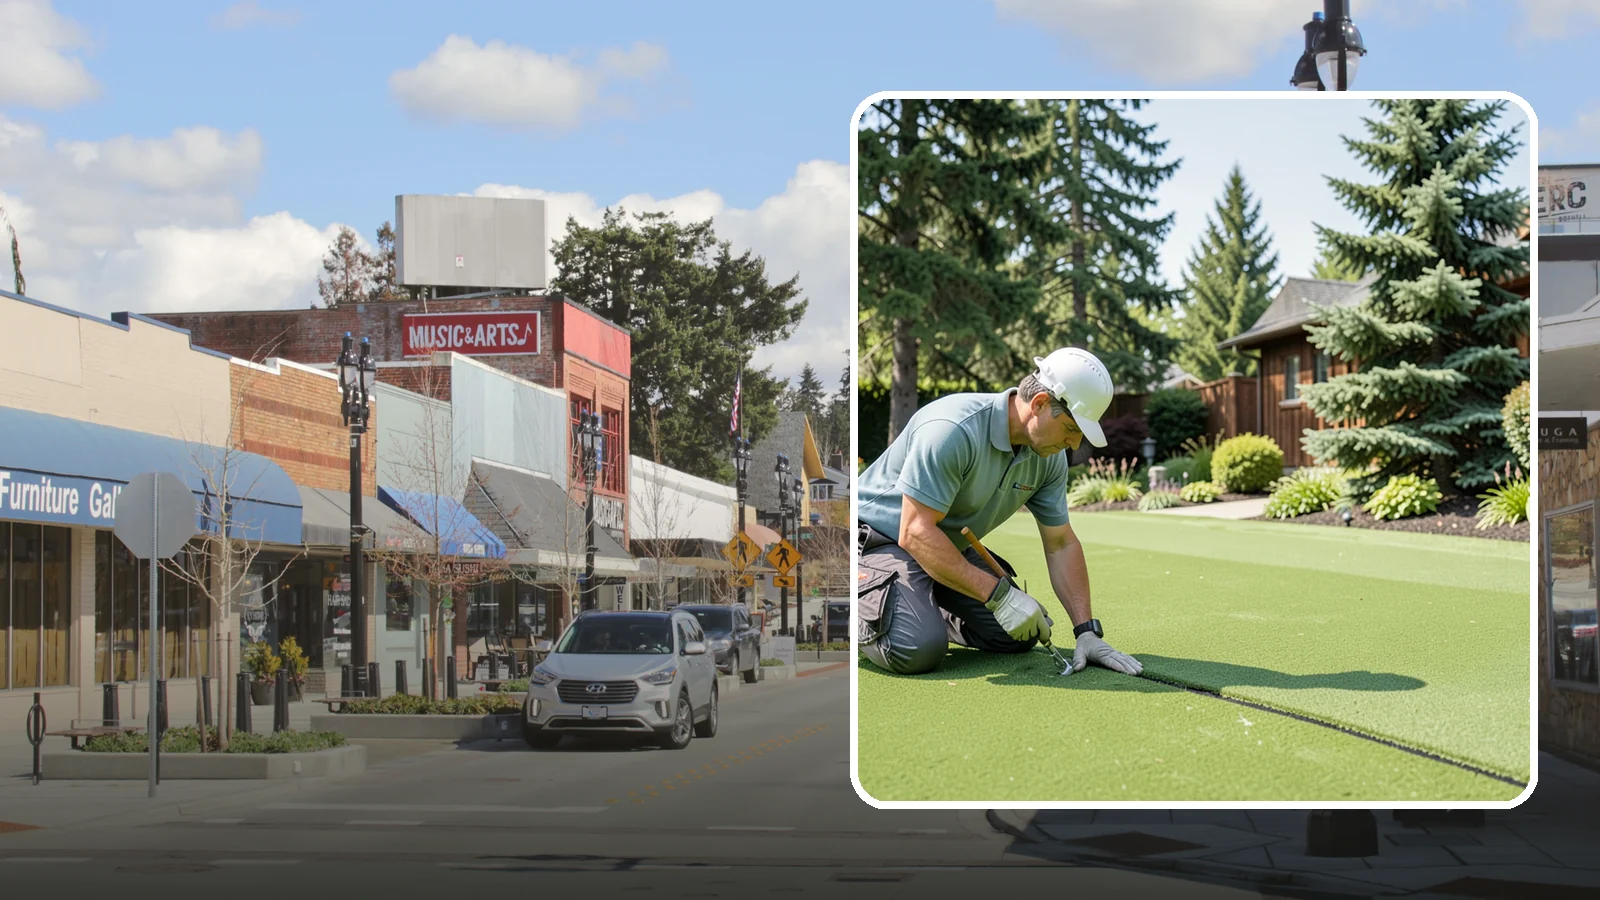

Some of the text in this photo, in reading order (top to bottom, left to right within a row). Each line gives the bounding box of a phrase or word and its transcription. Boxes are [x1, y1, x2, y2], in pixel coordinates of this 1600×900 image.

[409, 323, 519, 348] MUSIC&ARTS
[0, 471, 121, 519] Furniture Gal
[454, 563, 479, 574] SUSHI
